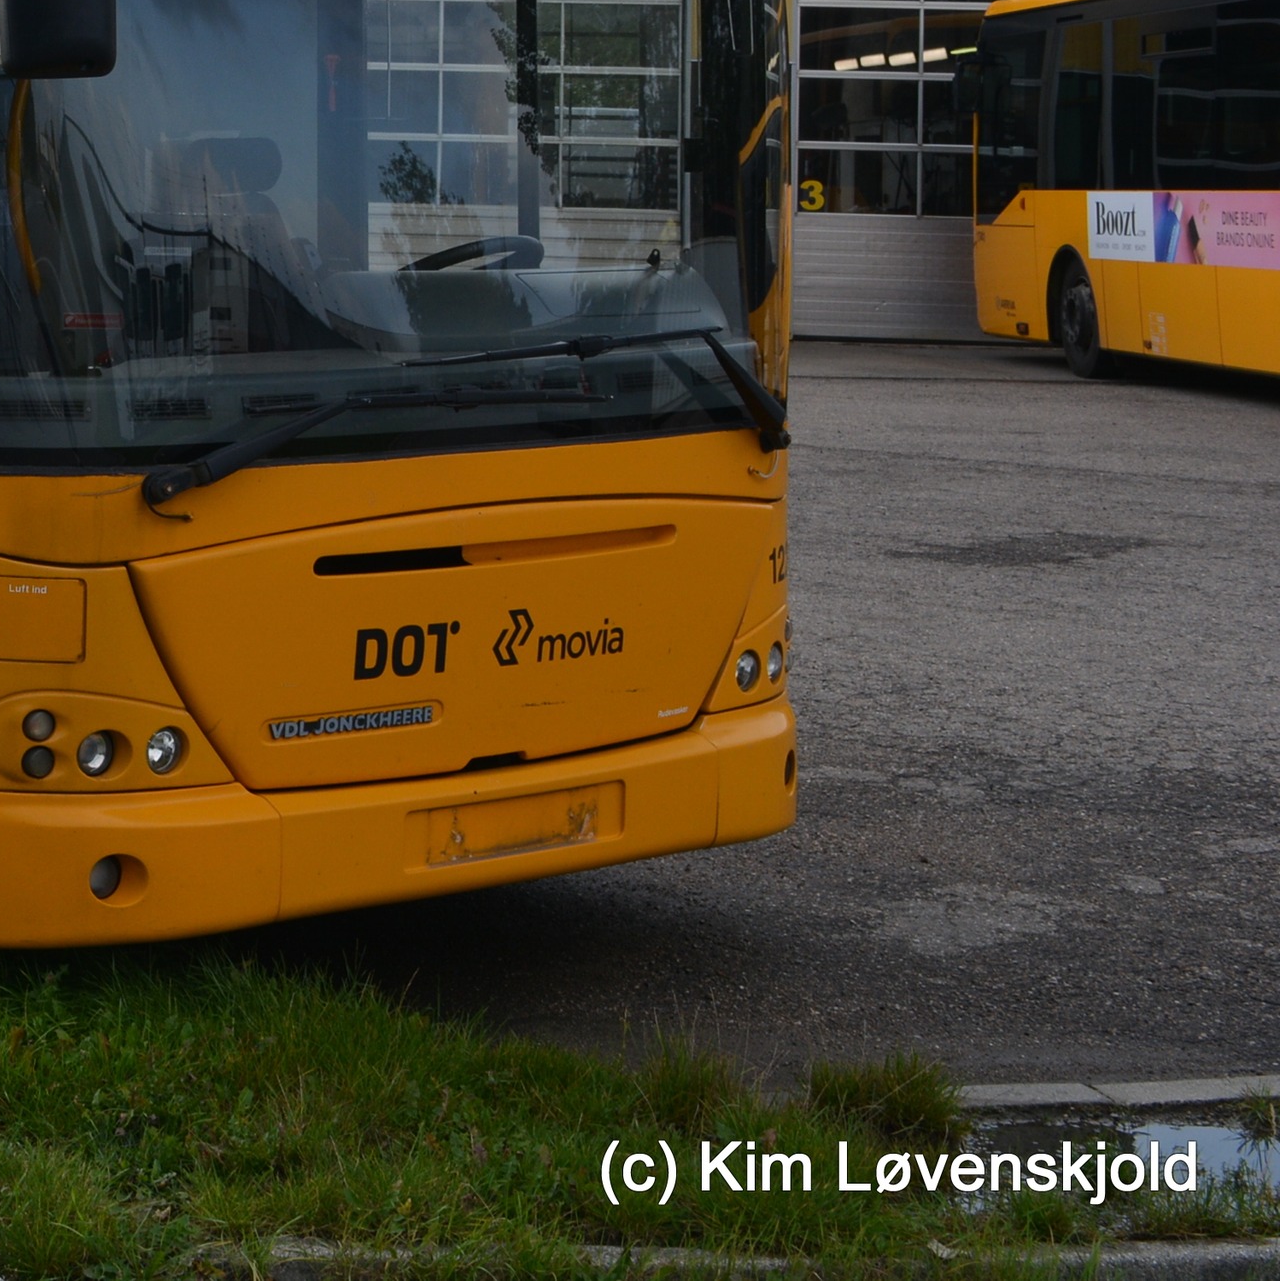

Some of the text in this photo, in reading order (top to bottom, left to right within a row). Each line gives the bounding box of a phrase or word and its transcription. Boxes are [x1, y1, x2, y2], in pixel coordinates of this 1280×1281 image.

[800, 180, 825, 210] 3
[1095, 201, 1137, 237] Boozt
[1240, 210, 1268, 227] BEAUTY
[1216, 231, 1275, 249] BRANDS ONLINE
[8, 584, 30, 594] Luft
[536, 617, 625, 663] movia
[270, 706, 434, 740] VDL JONCKHEERE
